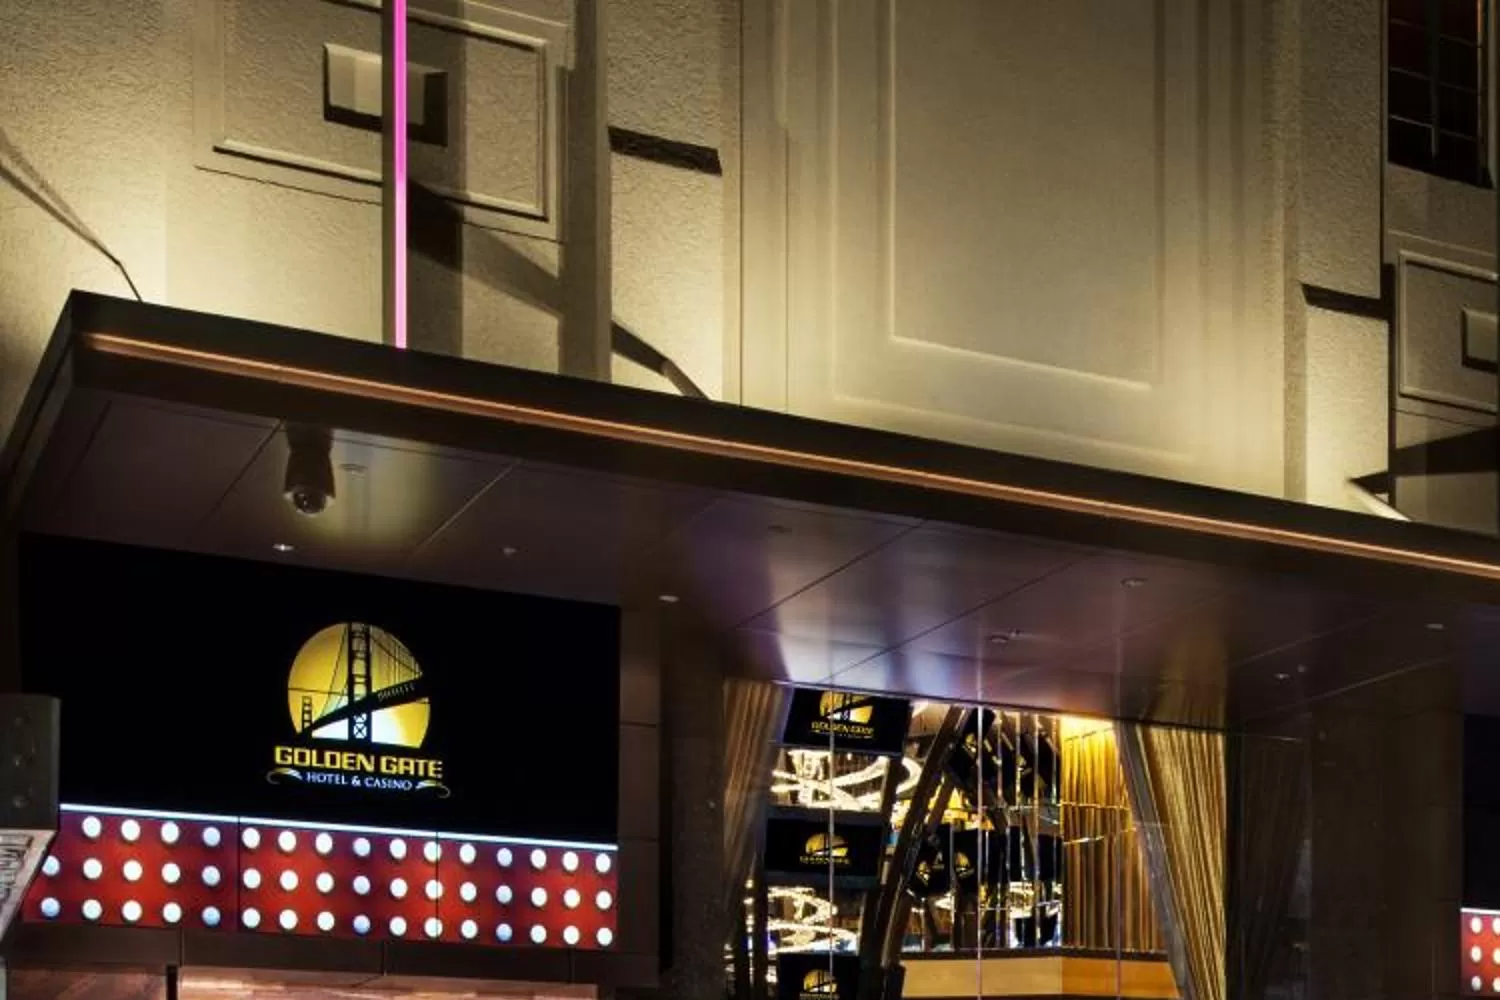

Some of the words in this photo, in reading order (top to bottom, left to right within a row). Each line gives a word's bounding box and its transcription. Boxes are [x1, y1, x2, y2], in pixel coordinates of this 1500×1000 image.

[274, 745, 375, 773] GOLDEN
[379, 755, 443, 779] GATE
[306, 771, 348, 785] HOTEL
[351, 775, 361, 787] &
[364, 777, 413, 791] CASINO
